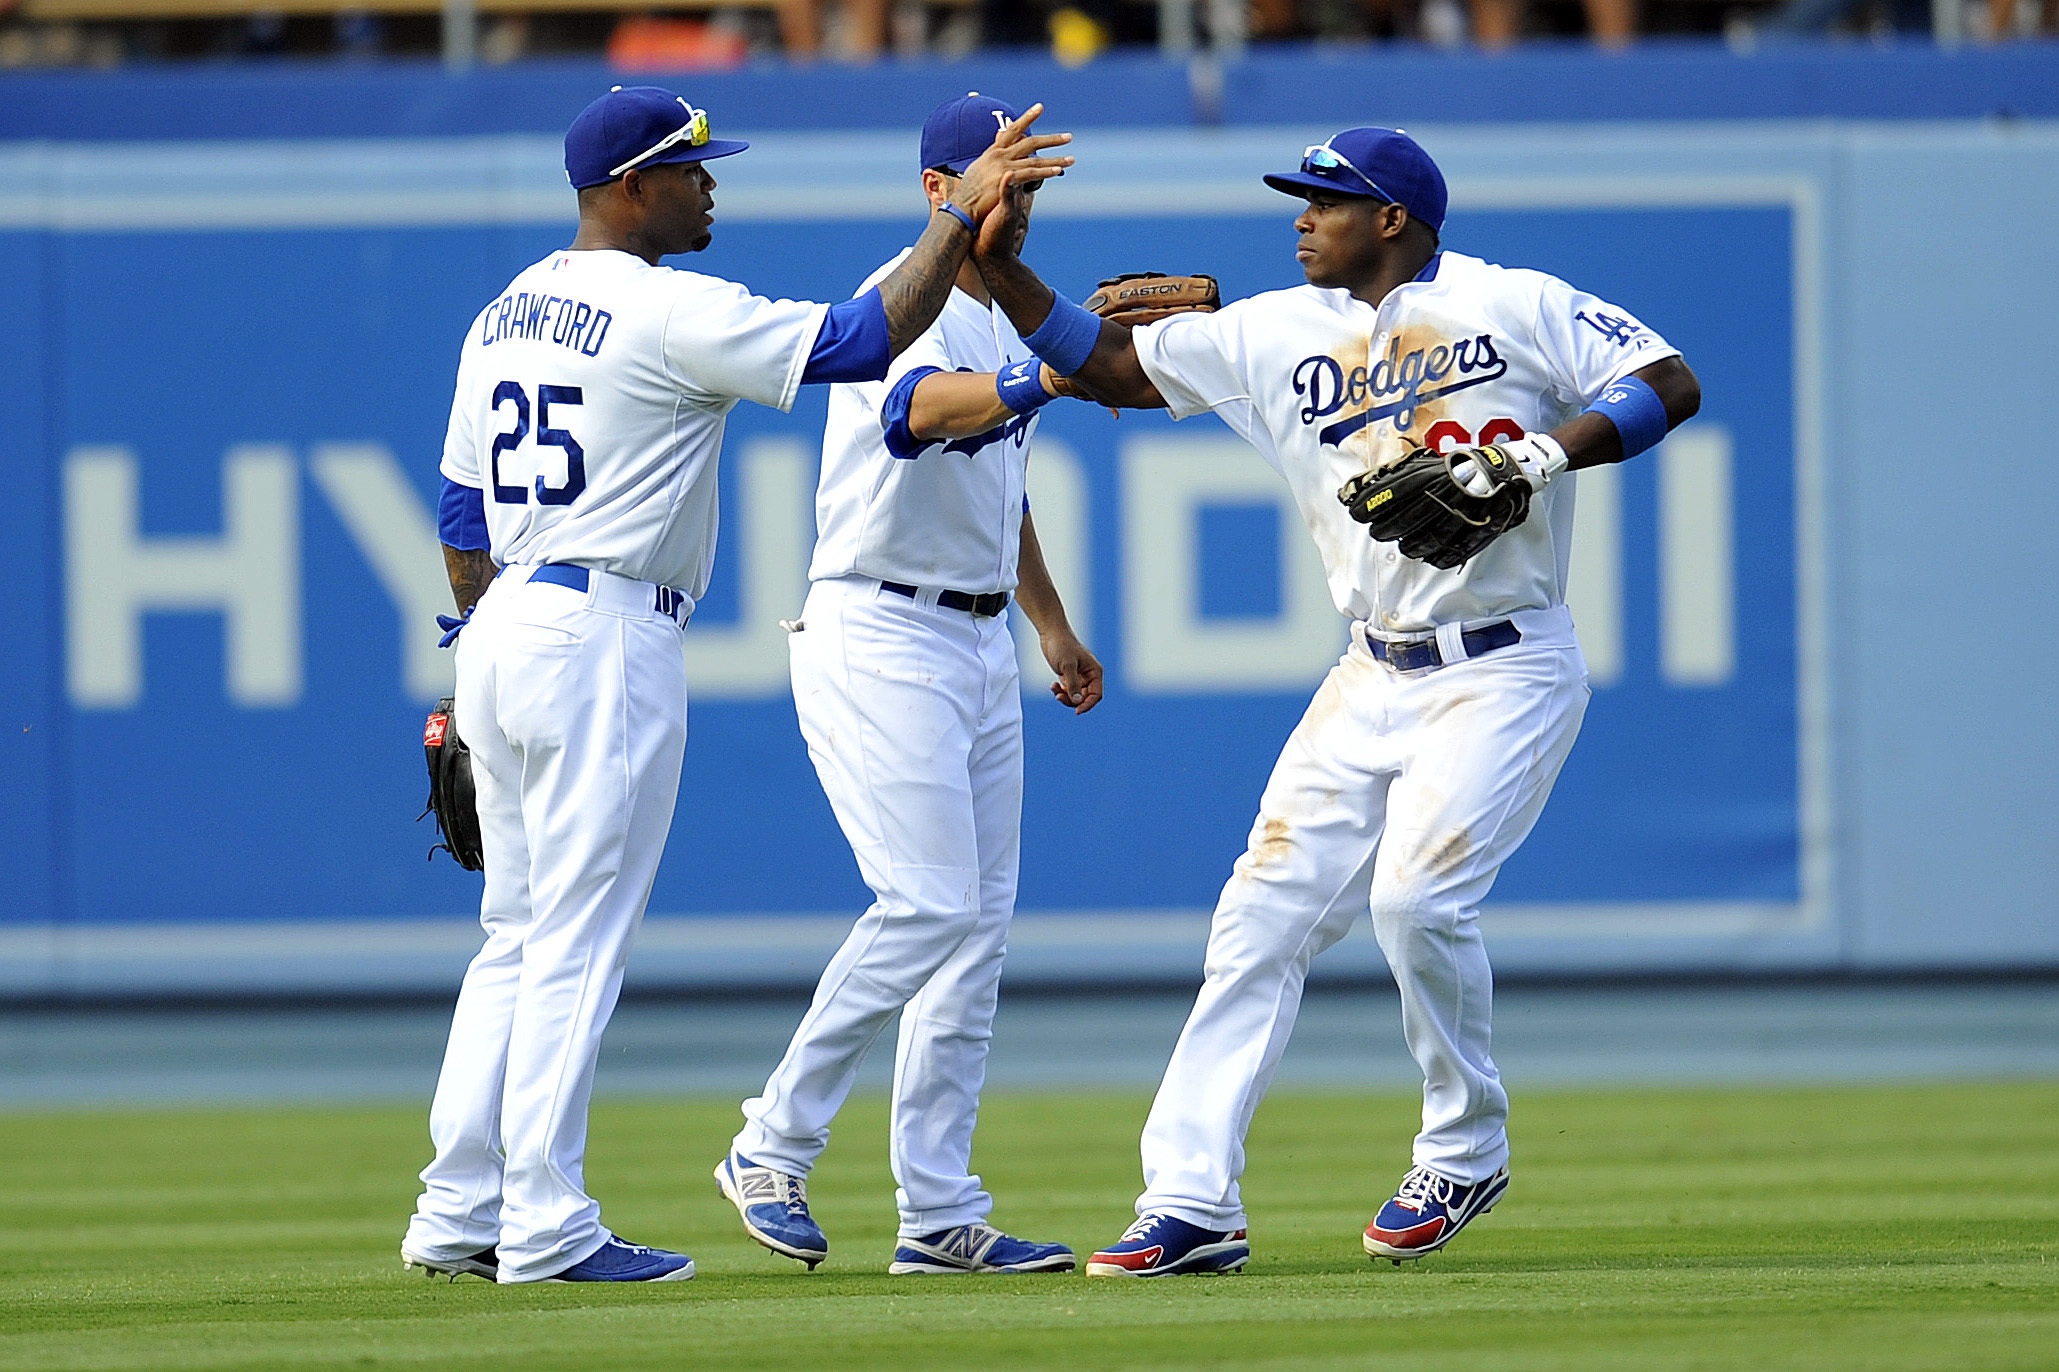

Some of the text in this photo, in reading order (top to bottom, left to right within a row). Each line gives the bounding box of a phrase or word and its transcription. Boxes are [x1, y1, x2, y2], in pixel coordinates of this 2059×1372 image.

[483, 292, 613, 357] CRAWFORD
[1119, 283, 1182, 299] EASTON
[1574, 310, 1641, 347] LA
[1292, 334, 1508, 446] Dodgers
[491, 380, 587, 506] 25
[62, 426, 1738, 710] HYUDI
